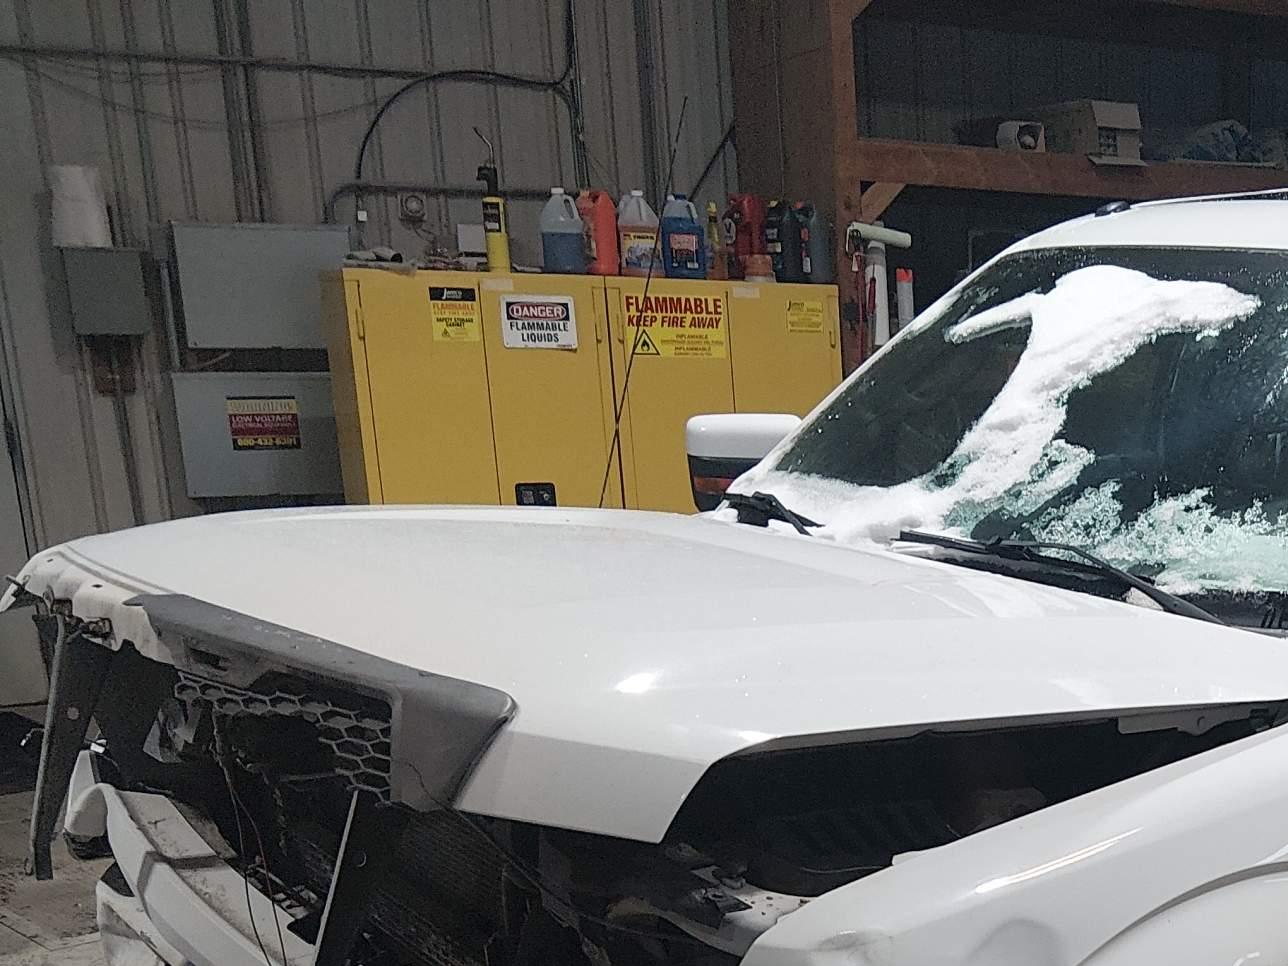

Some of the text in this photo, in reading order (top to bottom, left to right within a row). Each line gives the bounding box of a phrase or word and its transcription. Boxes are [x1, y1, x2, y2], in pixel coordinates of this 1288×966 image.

[625, 296, 722, 315] FLAMMABLE
[513, 306, 562, 317] DANGER
[510, 321, 569, 332] FLAMMABLE
[627, 315, 722, 329] KEEP FIRE AWAY
[521, 333, 560, 343] LIQUIDS
[231, 415, 252, 423] LOW
